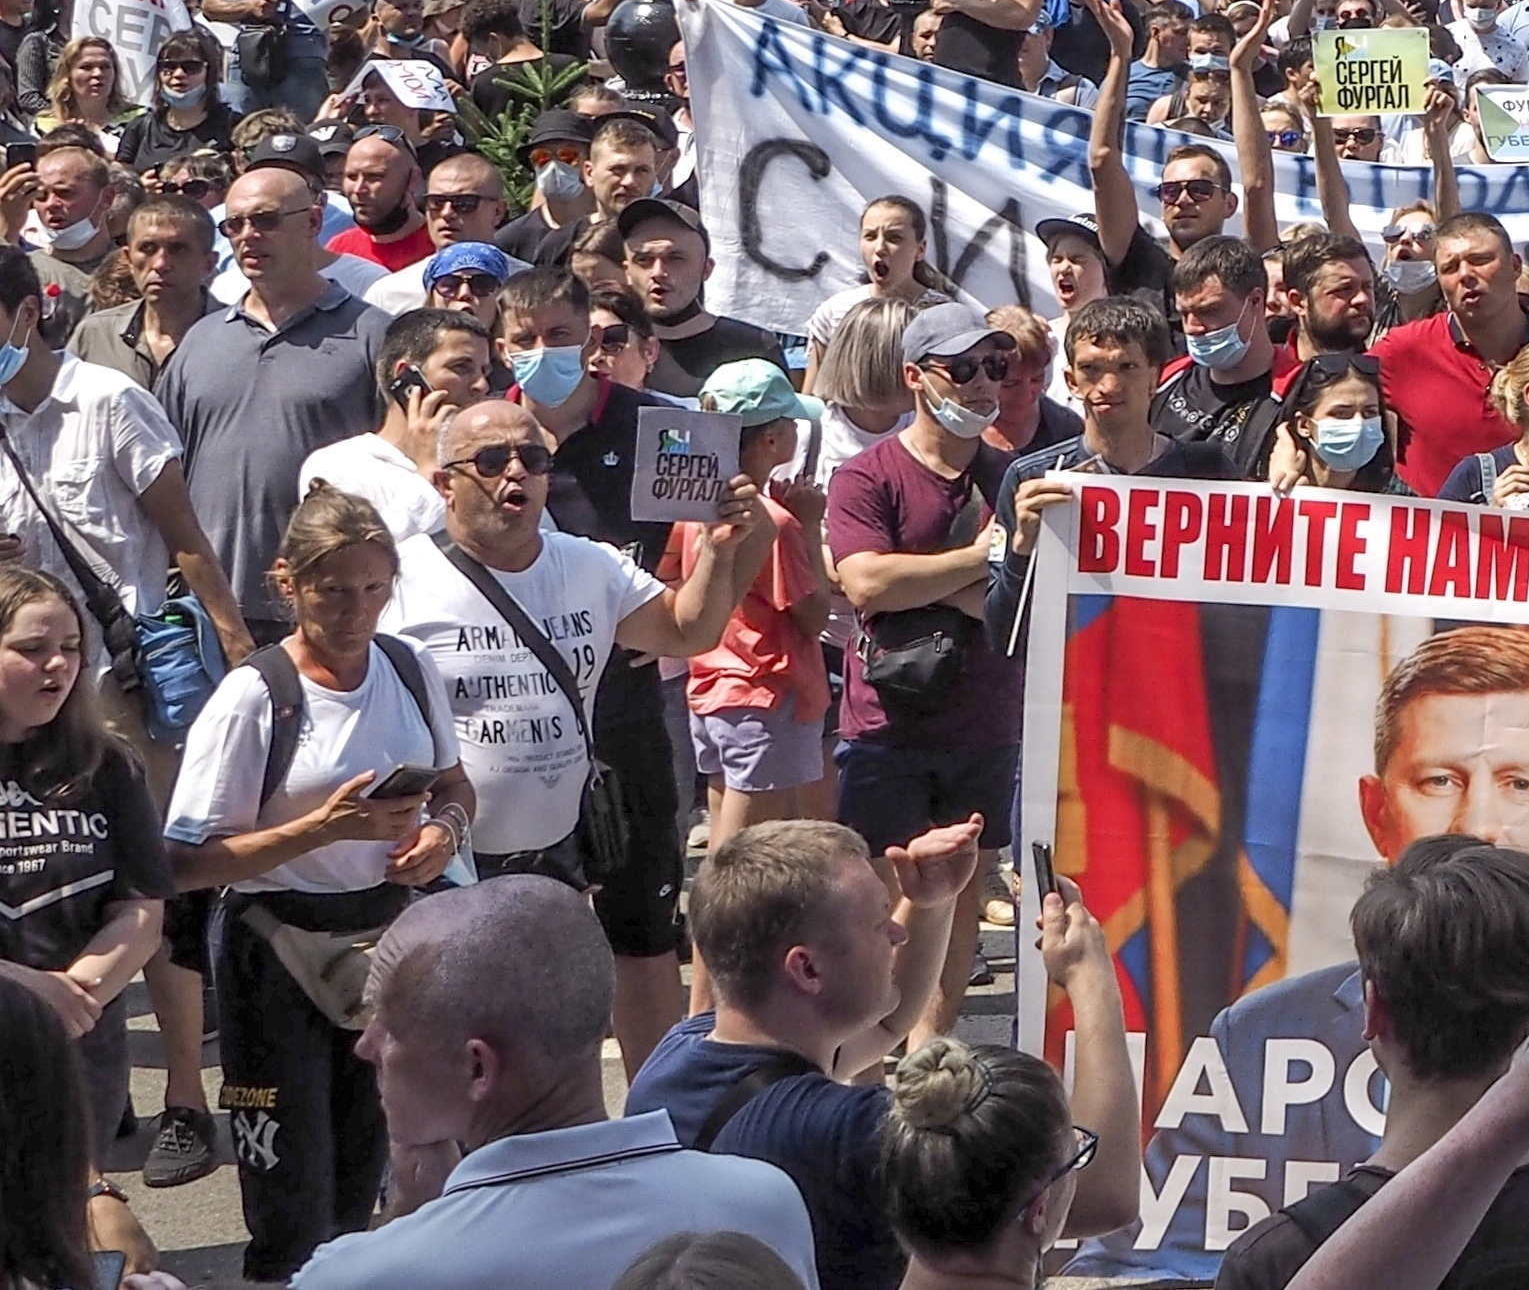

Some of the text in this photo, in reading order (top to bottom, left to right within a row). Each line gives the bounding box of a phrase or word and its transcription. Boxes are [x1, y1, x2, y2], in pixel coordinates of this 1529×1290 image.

[1336, 55, 1402, 85] СЕРГЕЙ
[752, 19, 1093, 188] АКЦИЯ
[1337, 85, 1409, 110] ФУРГАЛ
[656, 453, 719, 479] СЕРГЕЙ
[652, 476, 724, 502] ФУРГАЛ
[1077, 485, 1372, 591] ВЕРНИТЕ
[454, 671, 557, 700] AUTHENTIC
[465, 716, 562, 745] GARMENTS
[61, 840, 95, 854] Brand
[17, 858, 46, 873] 1967
